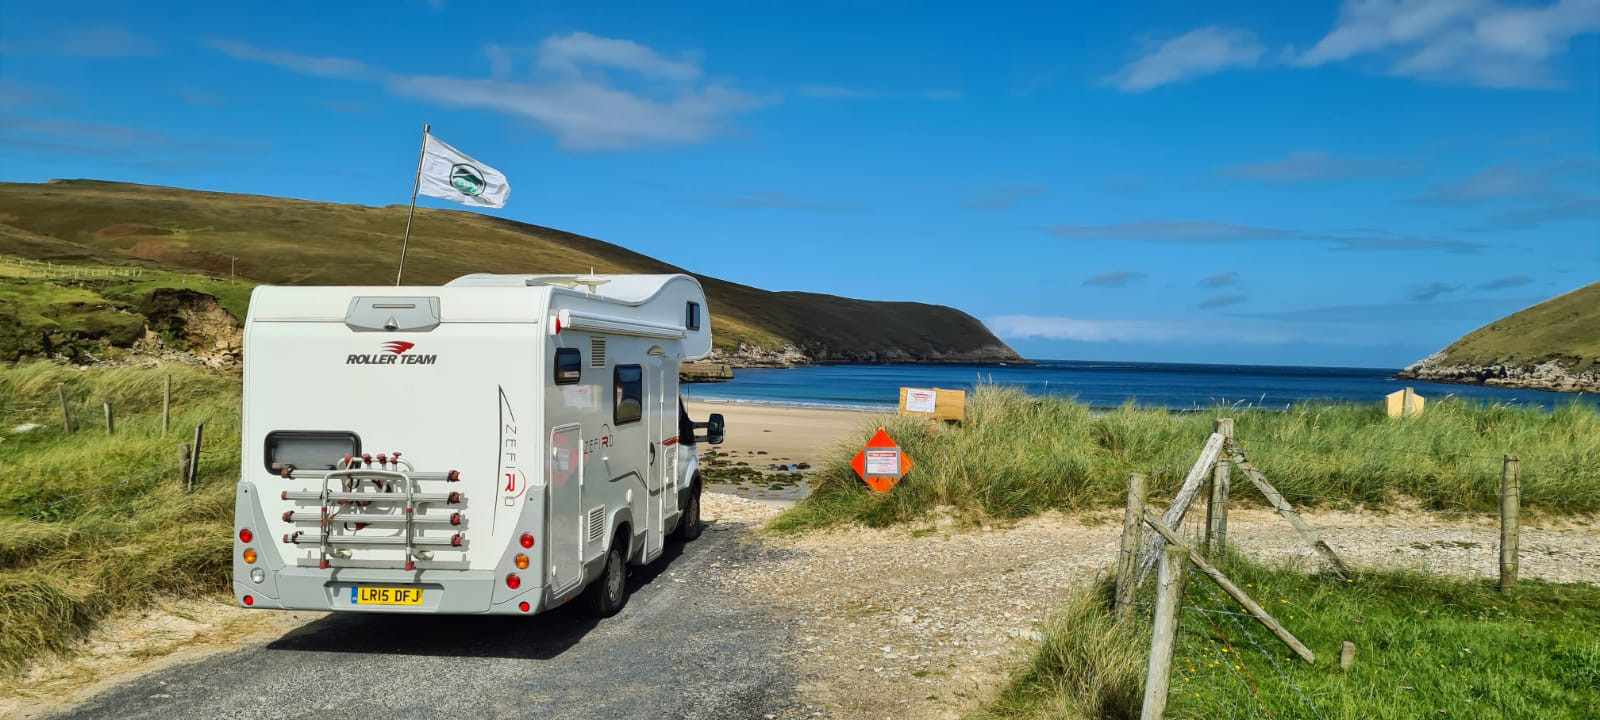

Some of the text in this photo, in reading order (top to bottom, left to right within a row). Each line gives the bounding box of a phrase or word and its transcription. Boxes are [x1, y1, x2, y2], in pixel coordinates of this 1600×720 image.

[346, 354, 437, 364] ROLLER TEAM
[361, 589, 420, 602] LR15 DFJ
